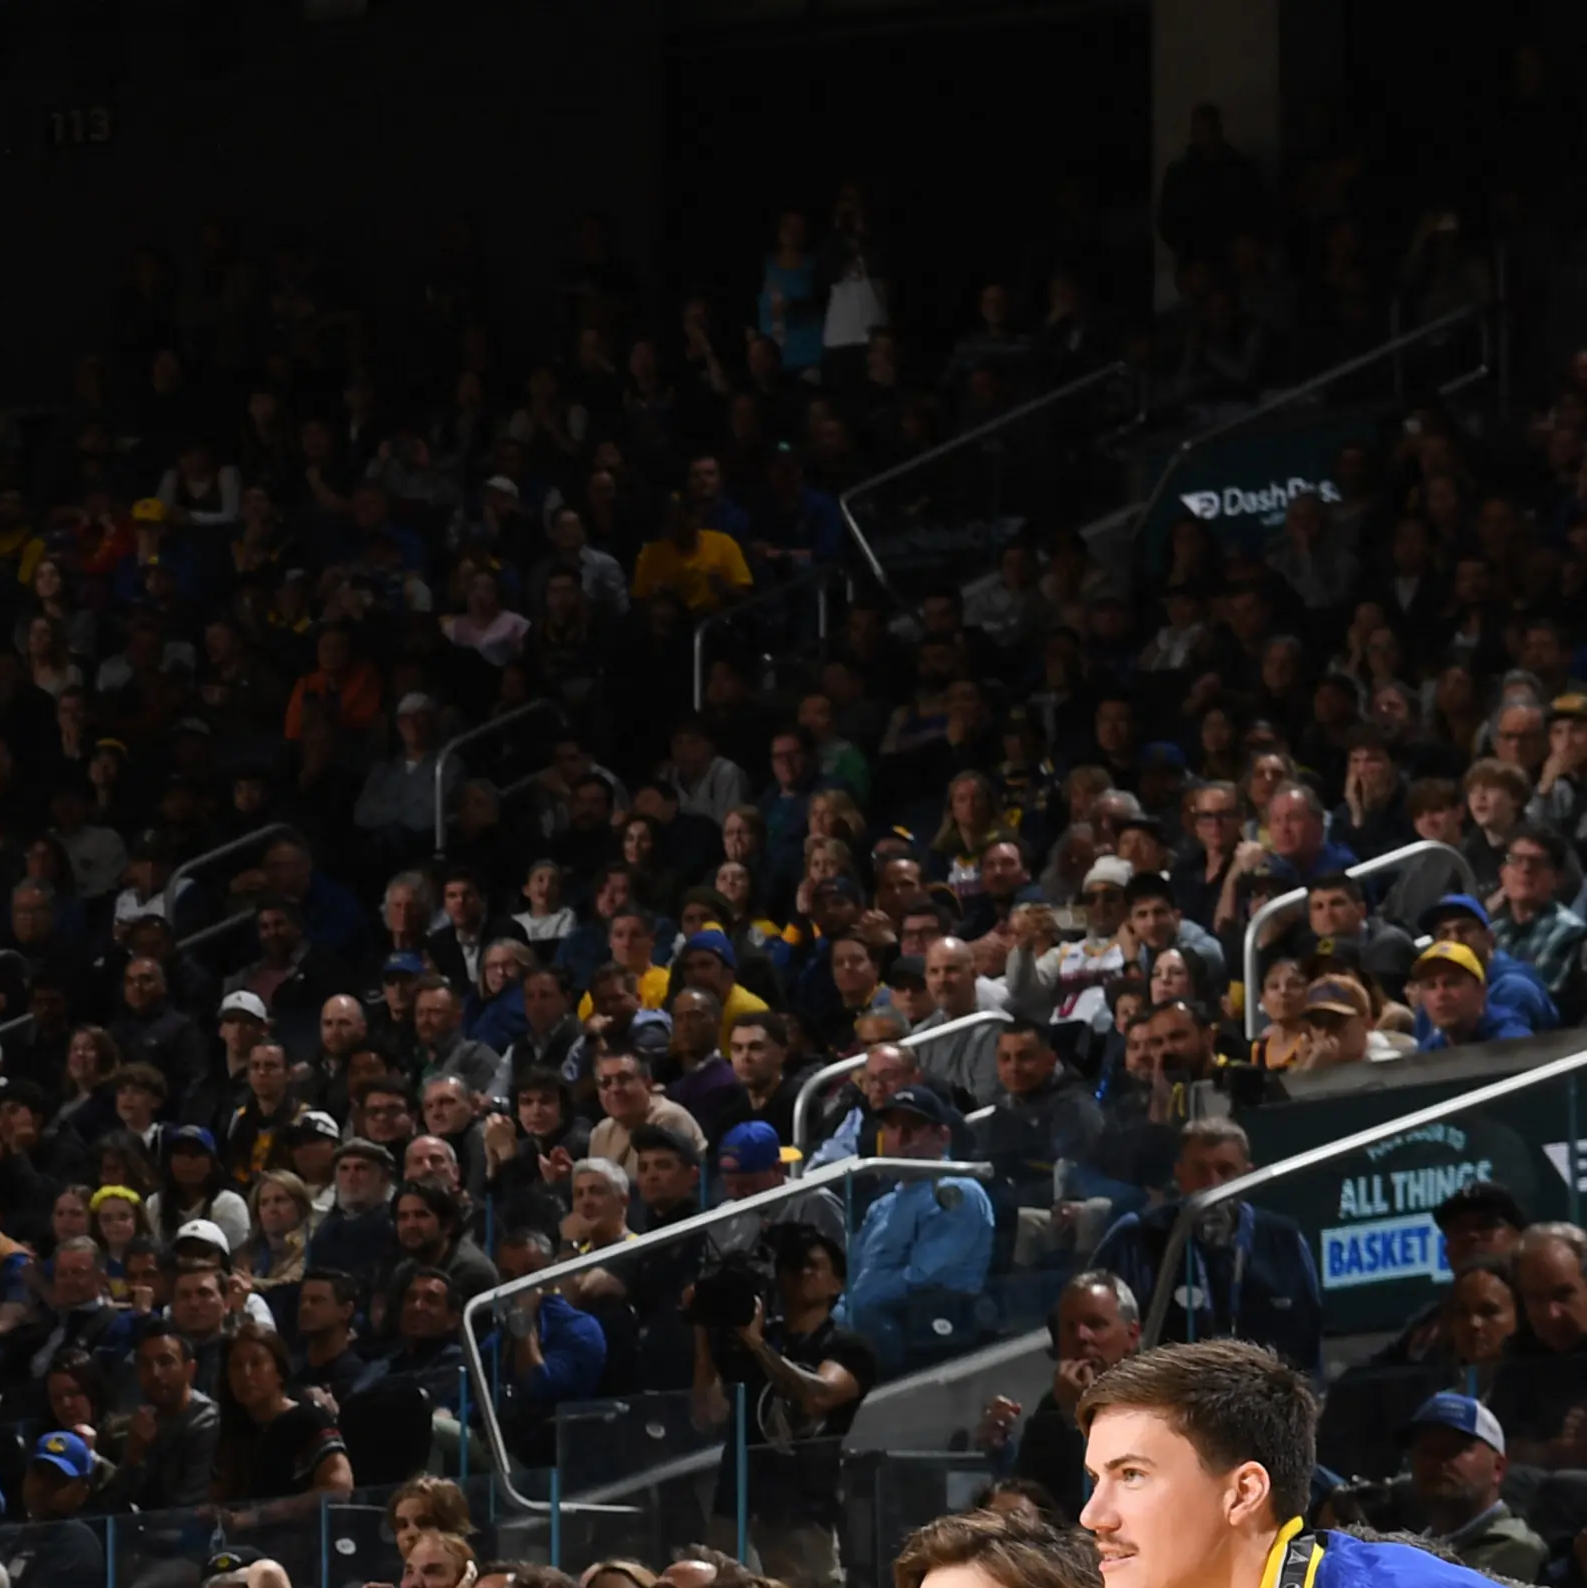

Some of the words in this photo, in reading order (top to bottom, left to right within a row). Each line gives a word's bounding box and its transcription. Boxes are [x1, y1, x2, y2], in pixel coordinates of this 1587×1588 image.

[50, 106, 111, 145] 113
[1338, 1173, 1390, 1221] ALL
[1328, 1224, 1432, 1278] BASKET
